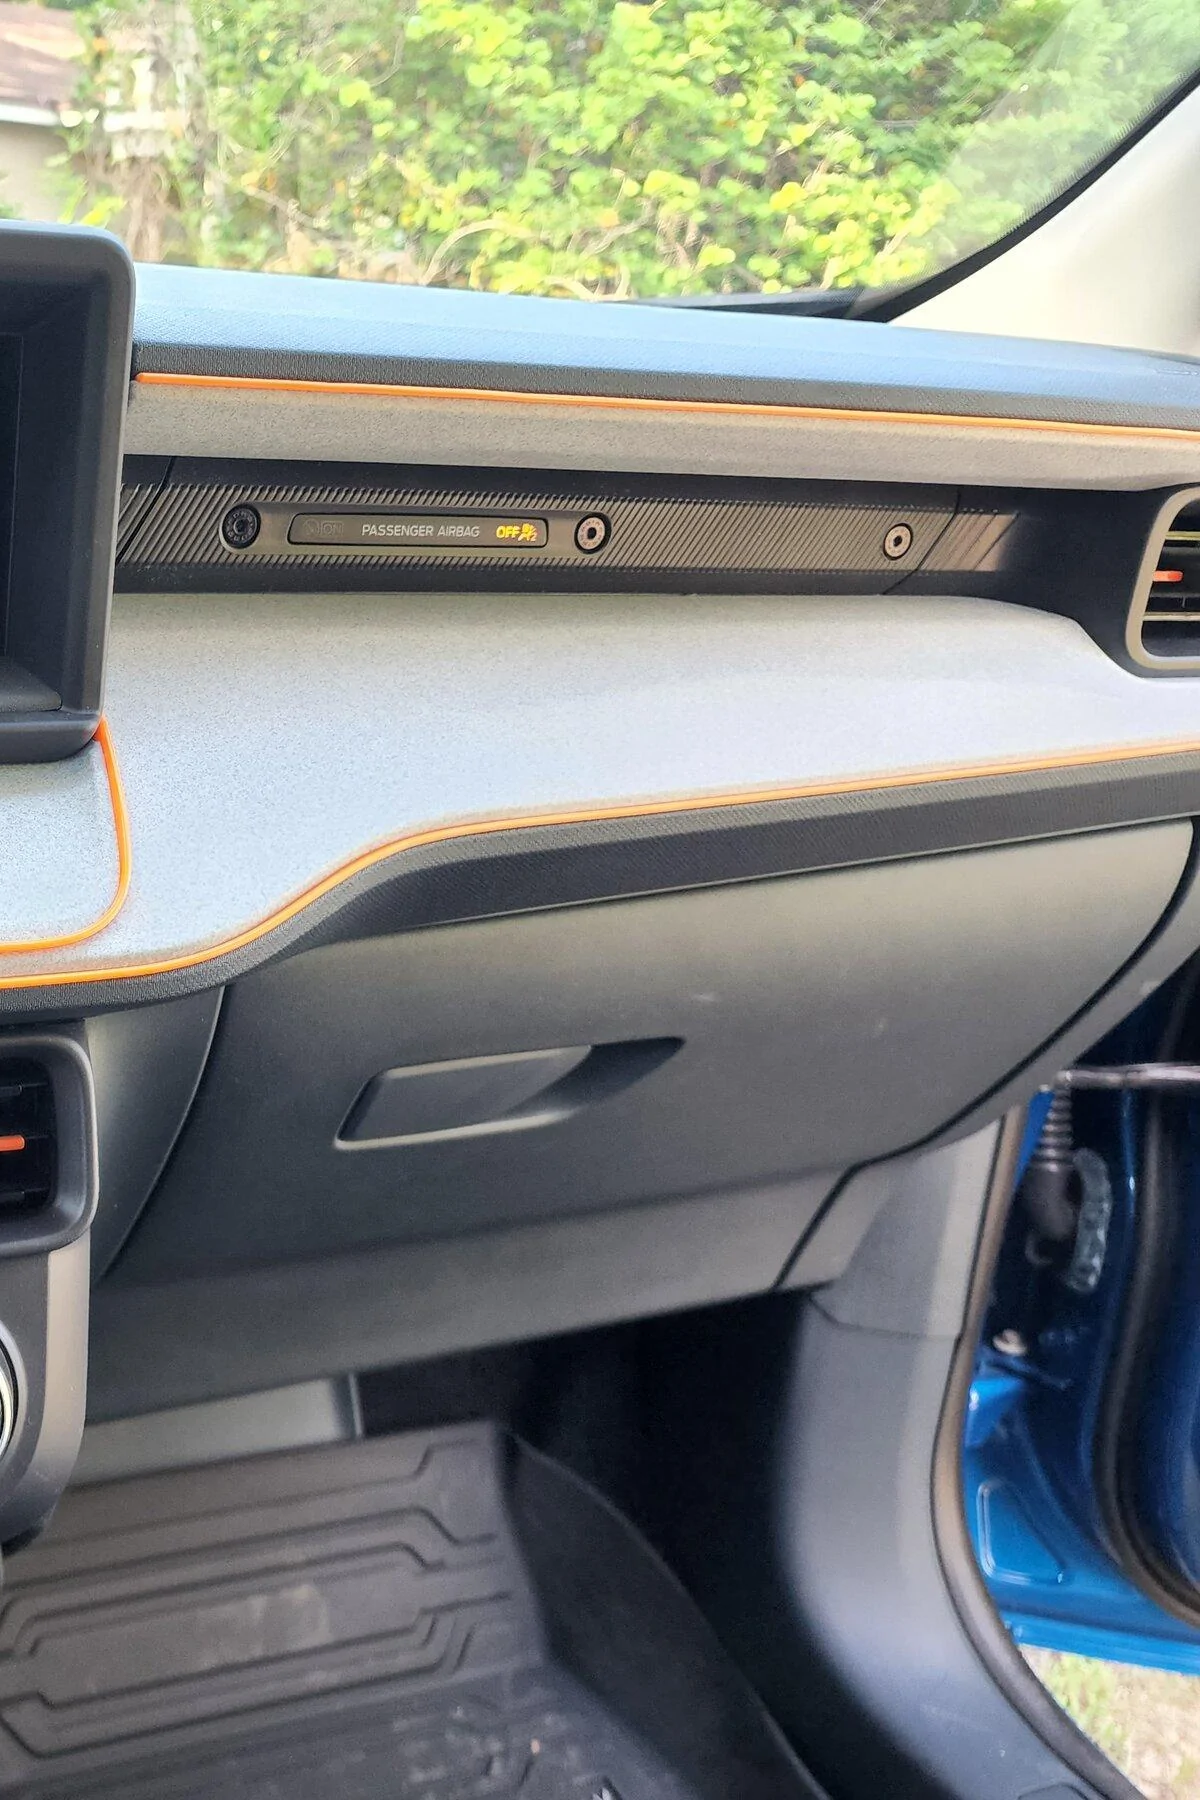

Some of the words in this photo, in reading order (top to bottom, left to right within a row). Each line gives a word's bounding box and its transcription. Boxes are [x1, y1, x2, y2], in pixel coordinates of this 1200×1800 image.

[361, 523, 434, 538] PASSENGER
[438, 524, 480, 538] AIRBAG
[496, 525, 521, 539] OFF
